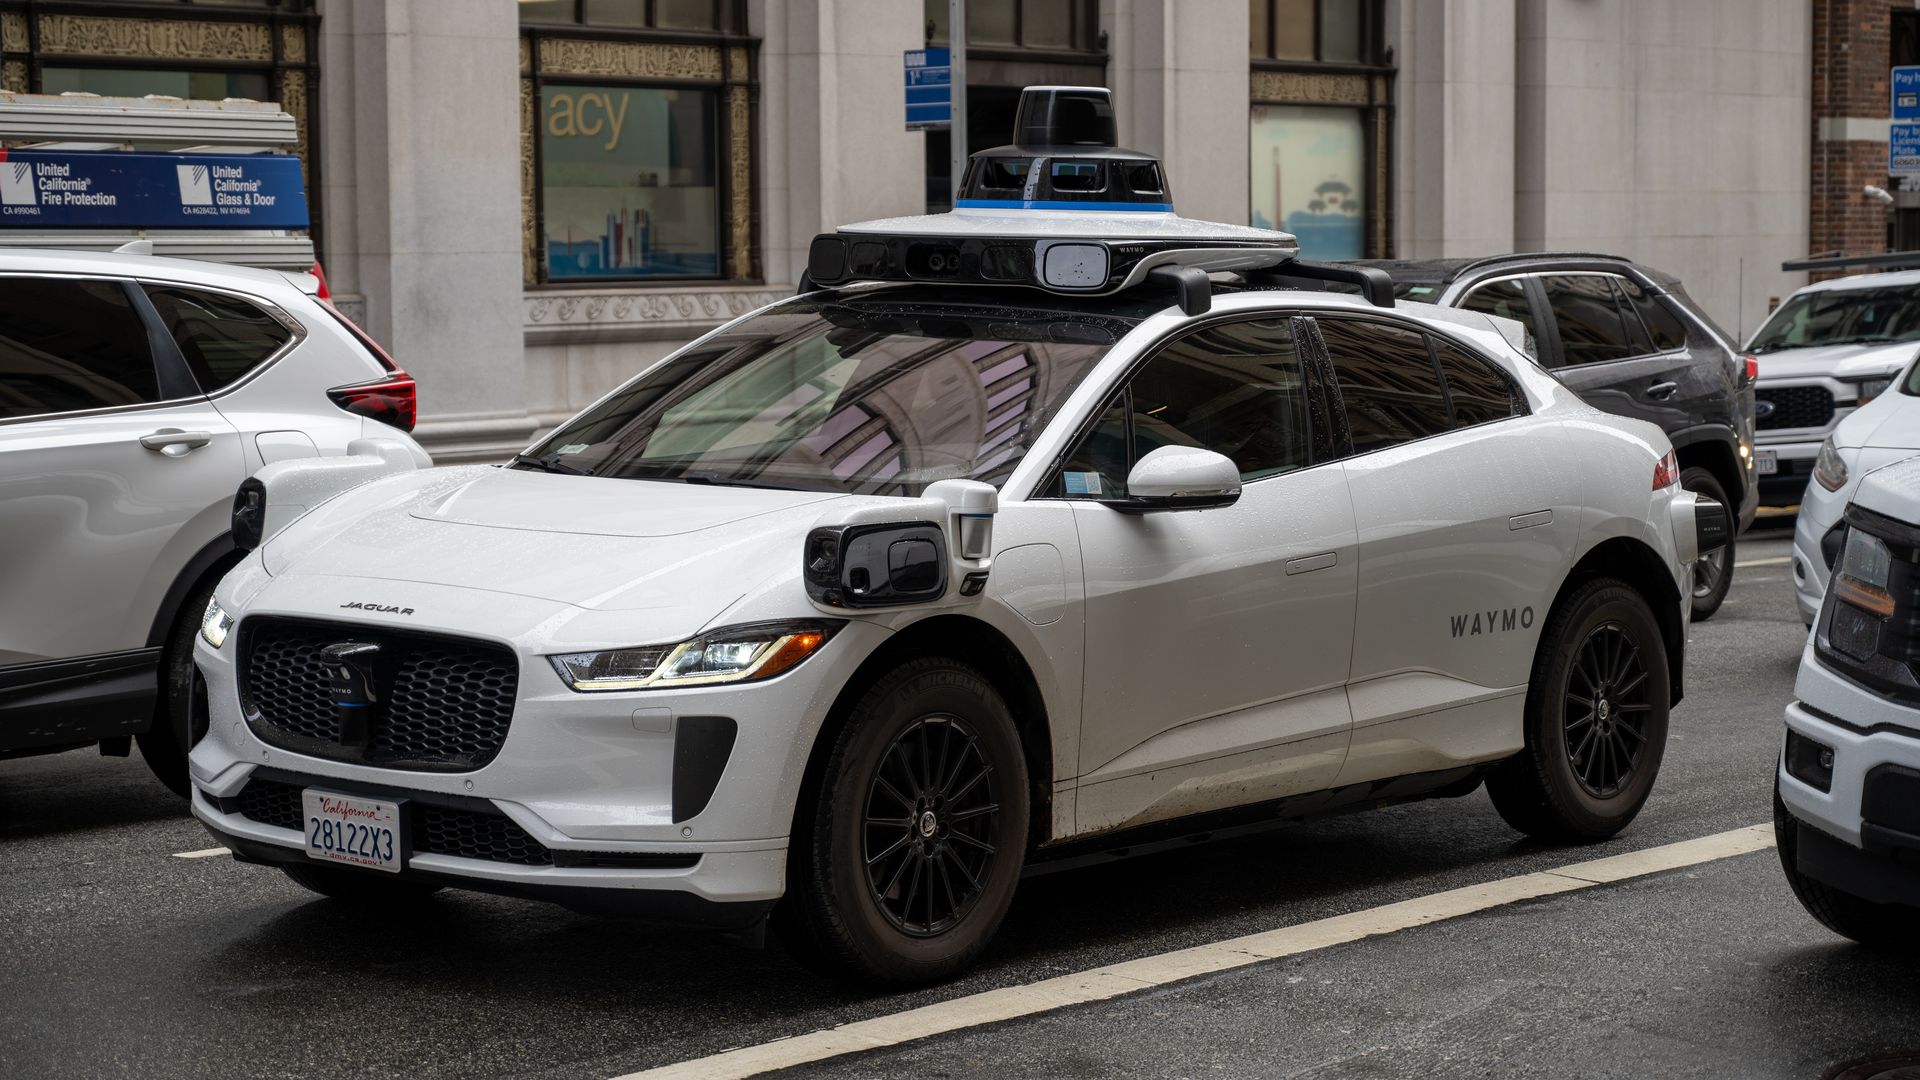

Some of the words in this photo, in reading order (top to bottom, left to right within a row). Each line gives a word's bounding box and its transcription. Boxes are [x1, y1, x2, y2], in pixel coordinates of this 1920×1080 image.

[1895, 72, 1914, 86] Pay
[548, 92, 630, 151] acy
[36, 163, 70, 177] United
[212, 165, 242, 179] United
[41, 192, 62, 205] Fire
[64, 192, 116, 206] Protection
[216, 193, 242, 206] Glass
[244, 193, 252, 206] &
[253, 193, 276, 206] Door
[3, 206, 13, 215] CA
[14, 207, 41, 215] #990461
[182, 206, 193, 215] CA
[340, 601, 415, 616] JAGUAR
[1450, 605, 1534, 639] WAYMO
[919, 671, 985, 697] MICHELIN
[322, 797, 382, 821] California
[310, 817, 393, 862] 28122X3
[329, 852, 378, 866] dmv.ca.gov
